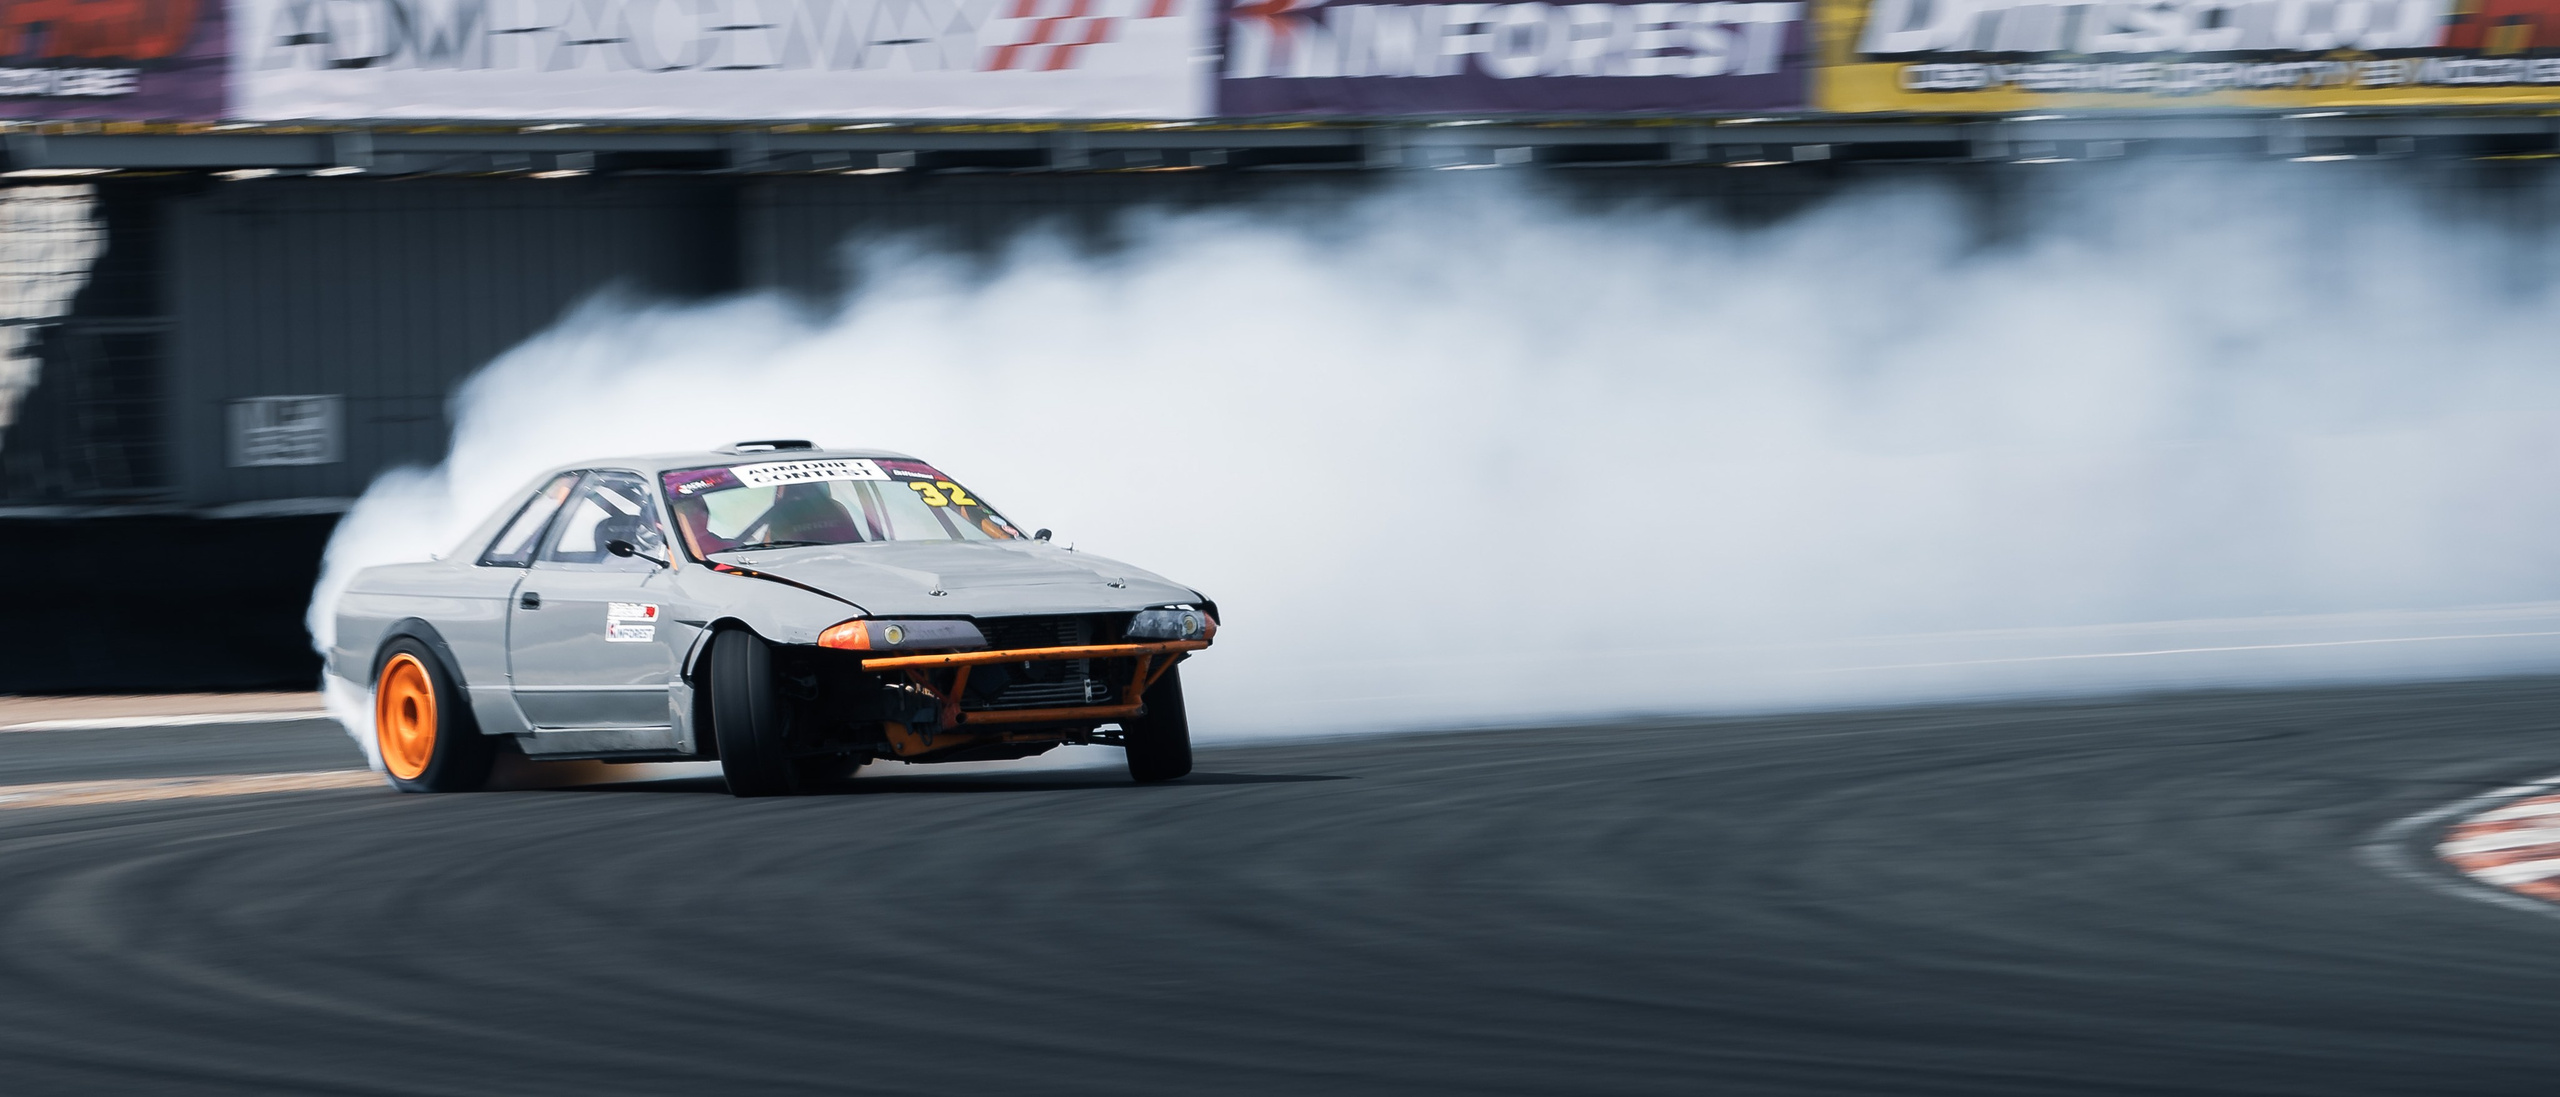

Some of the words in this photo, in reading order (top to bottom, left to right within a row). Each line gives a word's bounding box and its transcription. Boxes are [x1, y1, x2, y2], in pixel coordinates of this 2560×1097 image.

[749, 464, 800, 475] ADM
[802, 460, 866, 470] DRIFT
[753, 469, 873, 483] CONTEST
[908, 480, 978, 507] 32
